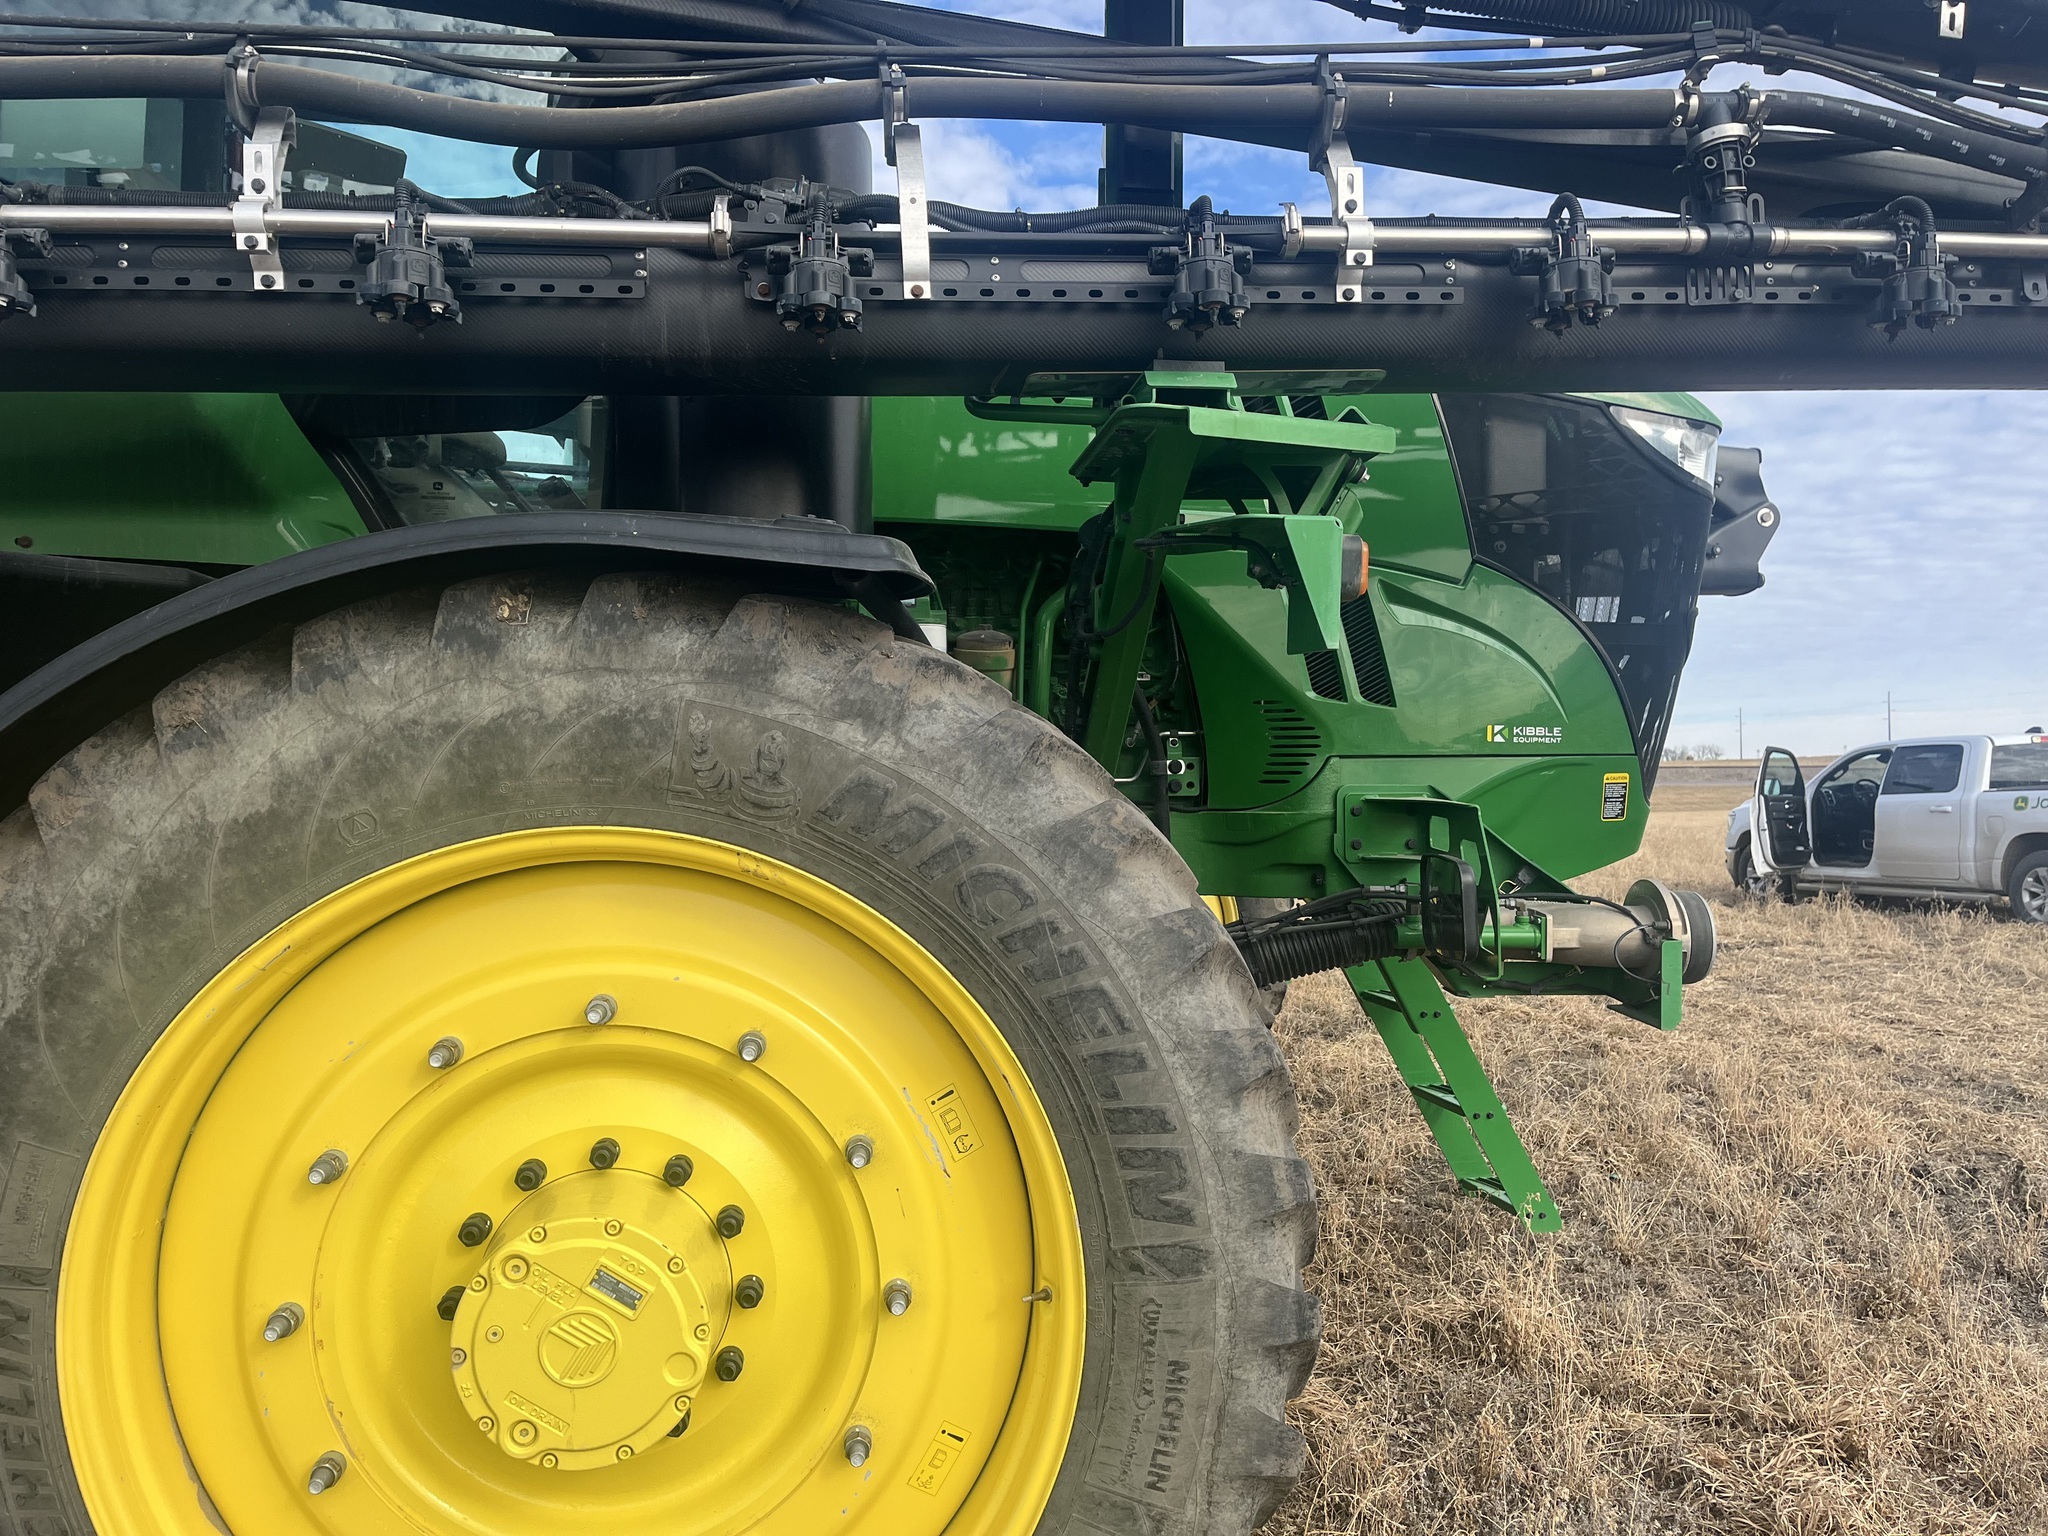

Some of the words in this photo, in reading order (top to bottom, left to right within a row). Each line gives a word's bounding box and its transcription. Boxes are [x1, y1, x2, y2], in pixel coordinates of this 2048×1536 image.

[1513, 727, 1562, 737] KIBBLE
[523, 808, 581, 820] MICHELIN
[810, 764, 1200, 1227] MICHELIN
[620, 1255, 647, 1277] TOP
[531, 1277, 565, 1305] LEVEL
[509, 1394, 527, 1411] OIL
[529, 1406, 566, 1432] DRAIN
[1144, 1359, 1191, 1493] MICHELIN
